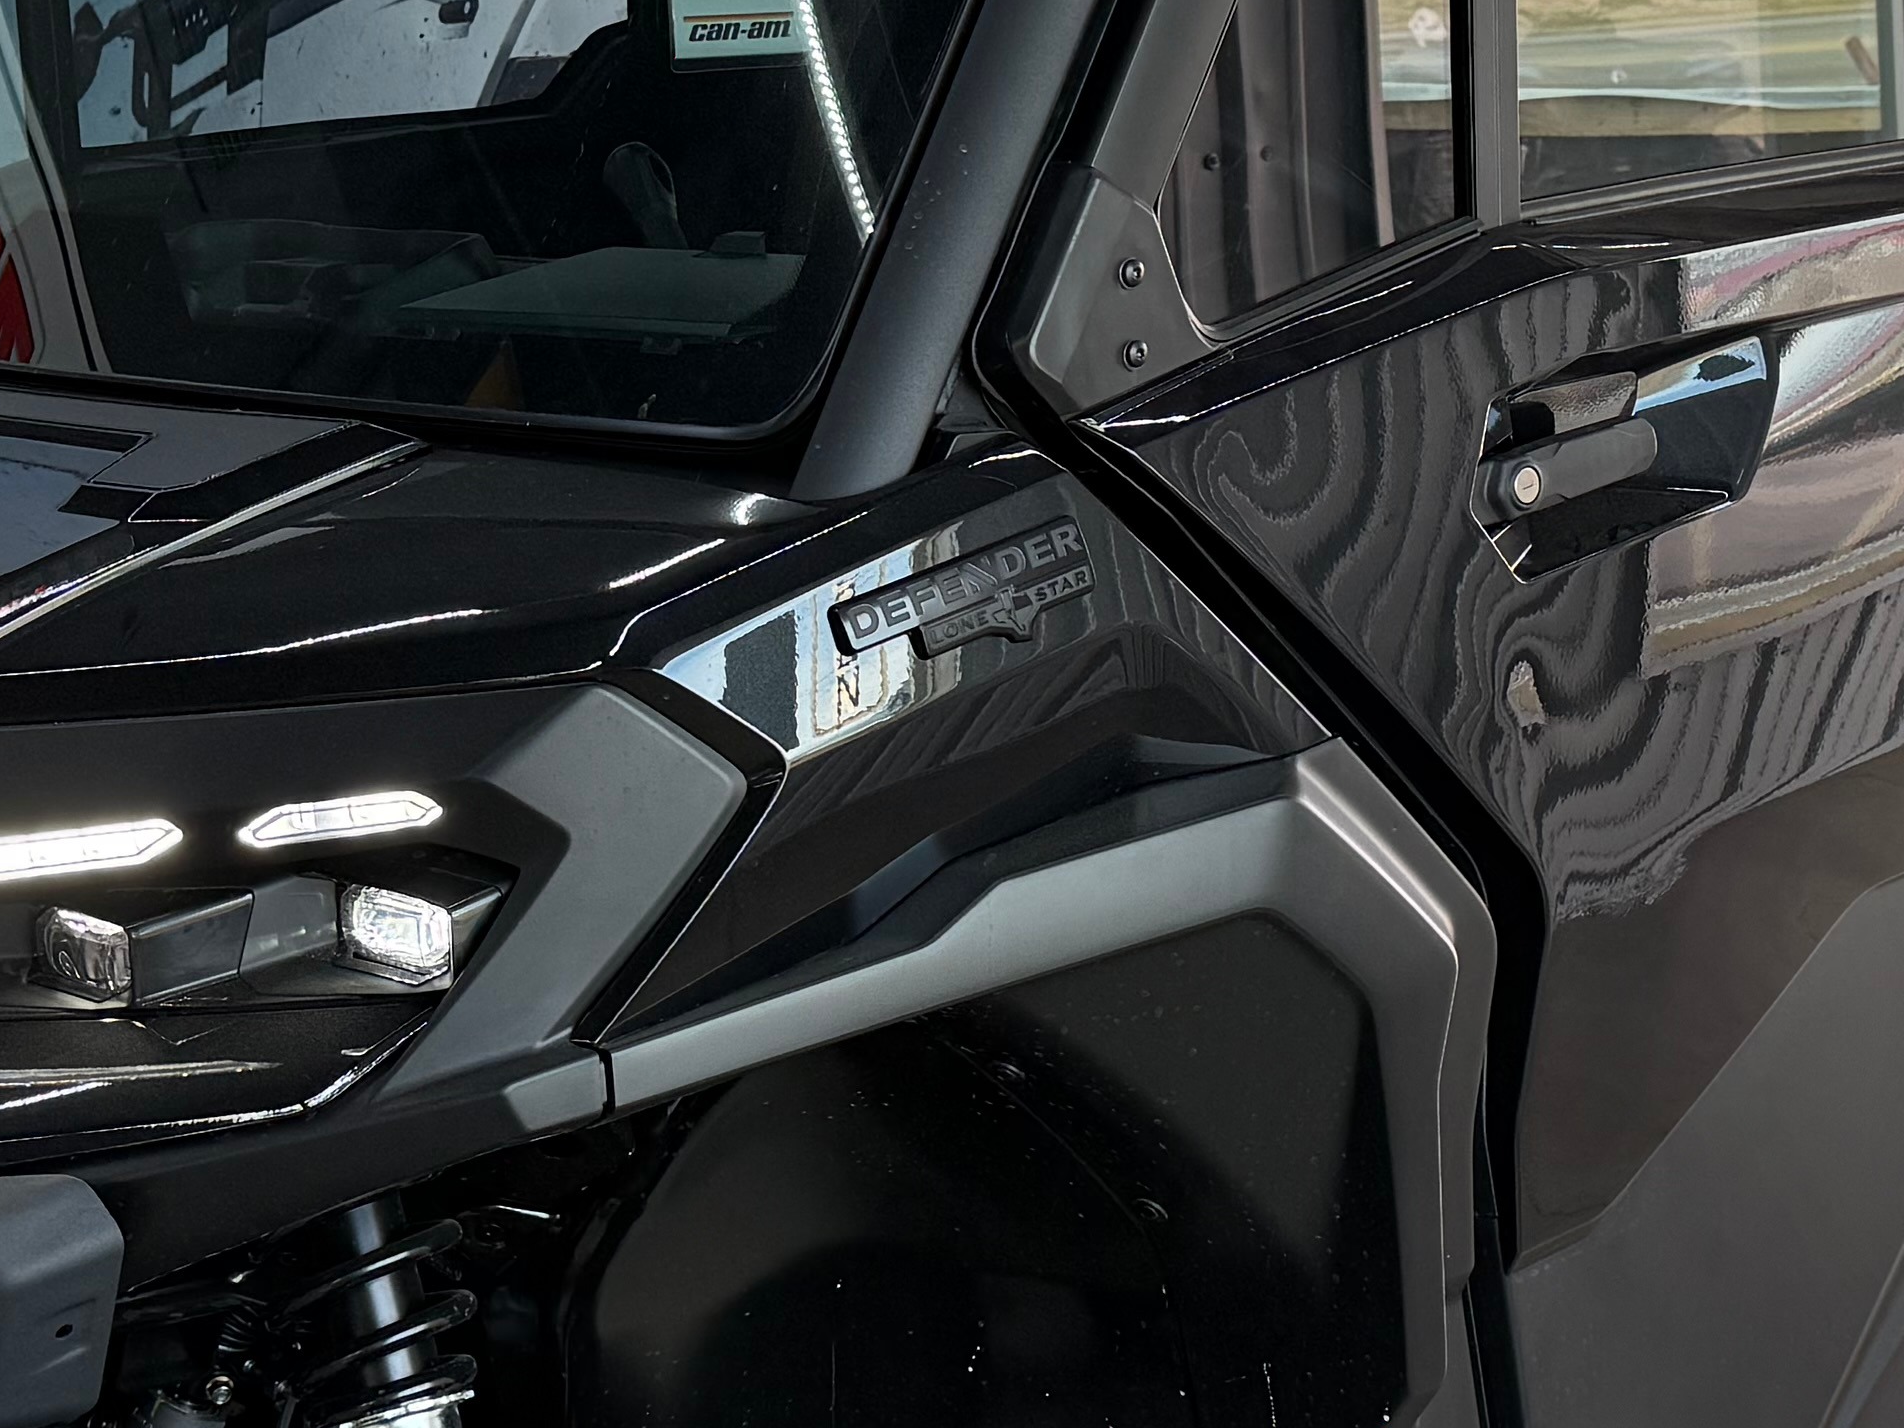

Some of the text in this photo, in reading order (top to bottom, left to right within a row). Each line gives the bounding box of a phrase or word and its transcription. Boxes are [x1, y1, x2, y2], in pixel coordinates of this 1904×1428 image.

[688, 19, 793, 42] can-am
[846, 523, 1084, 640] DEFENDER
[927, 569, 1089, 645] LONE STAR
